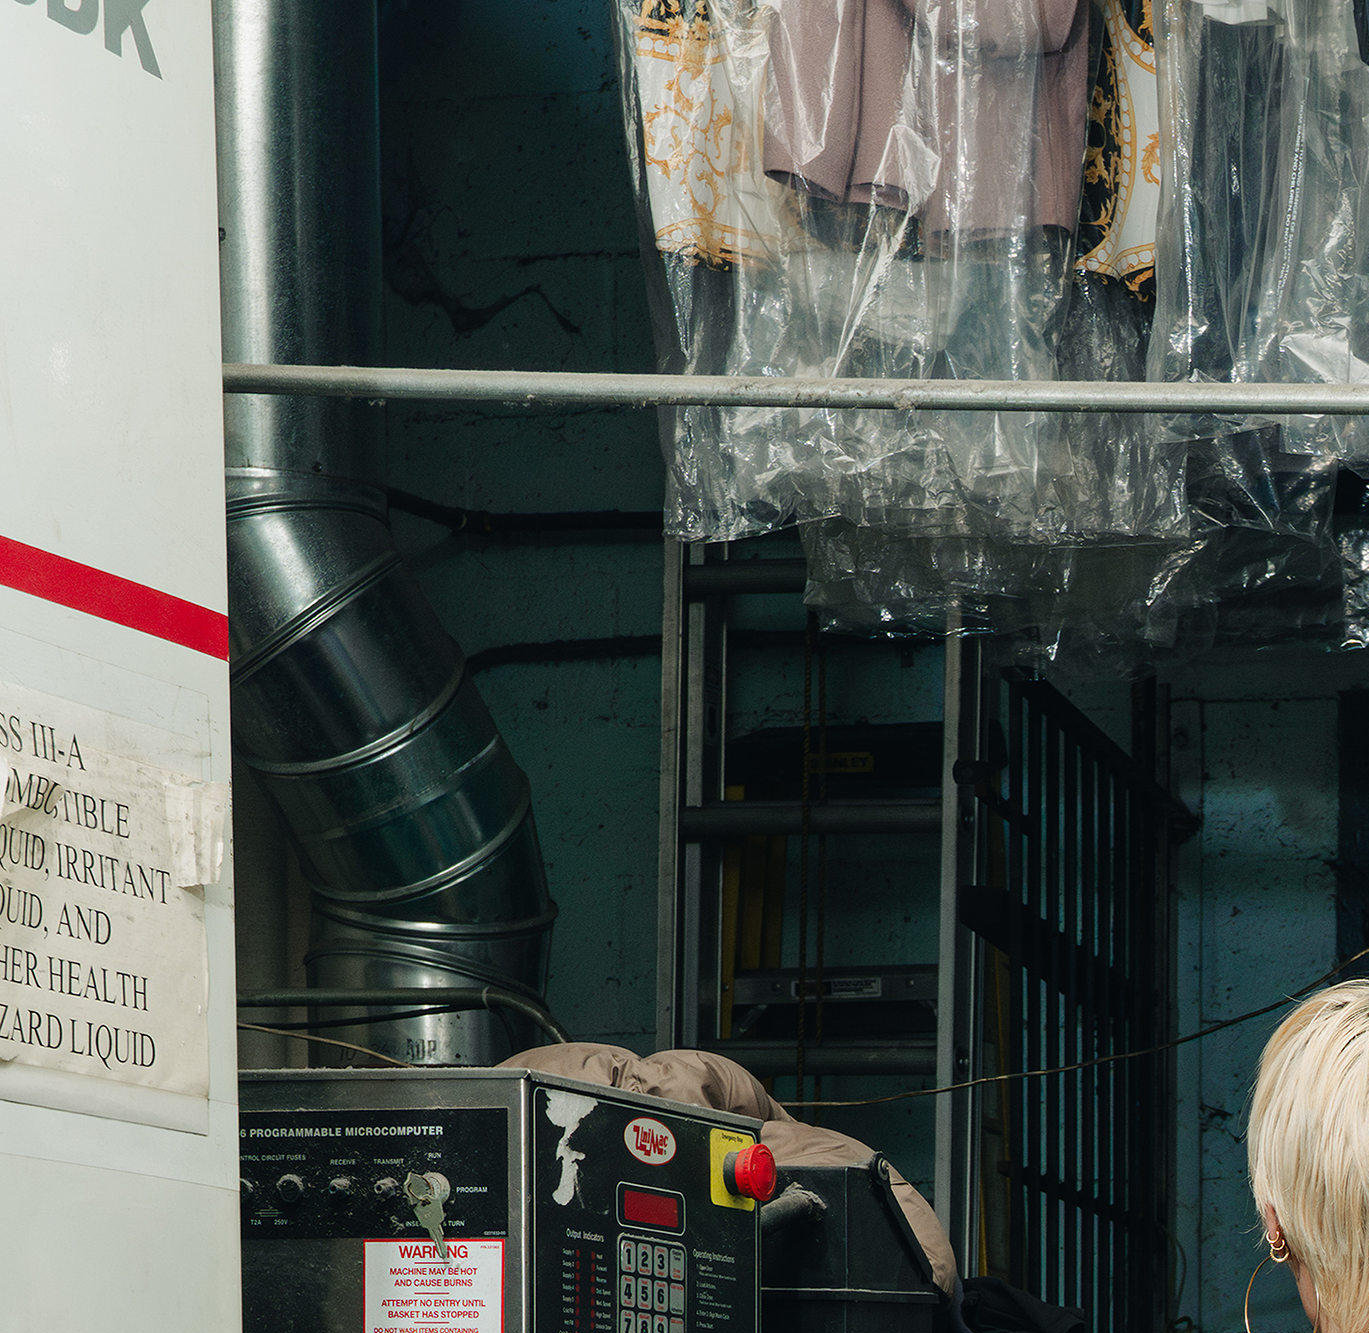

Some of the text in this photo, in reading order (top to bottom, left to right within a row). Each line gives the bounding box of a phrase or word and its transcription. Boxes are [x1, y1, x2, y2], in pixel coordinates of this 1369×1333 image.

[1292, 187, 1300, 220] DANGER
[1285, 214, 1291, 227] DO
[1290, 221, 1296, 232] OF
[30, 721, 87, 771] III-A
[56, 842, 170, 905] IRRITANT
[56, 902, 111, 945] AND
[48, 956, 149, 1012] HEALTH
[70, 1018, 156, 1071] LIQUID
[249, 1127, 342, 1138] PROGRAMMABLE
[345, 1125, 444, 1137] MICROCOMPUTER
[632, 1124, 669, 1157] UniMac
[260, 1154, 285, 1162] CIRCUIT
[456, 1186, 488, 1194] PROGRAM
[566, 1228, 605, 1242] Output Indicators
[398, 1245, 469, 1259] WARNNG
[625, 1248, 665, 1270] 1 2 3
[389, 1267, 478, 1276] MACHINE MAY BE HOT
[394, 1278, 473, 1287] AND CAUSE BURNS
[624, 1283, 665, 1304] 4 5 6
[381, 1299, 486, 1307] ATTEMPT NO ENTRY UNTIL
[387, 1310, 480, 1319] BASKET HAS STOPPED
[624, 1317, 632, 1333] 7
